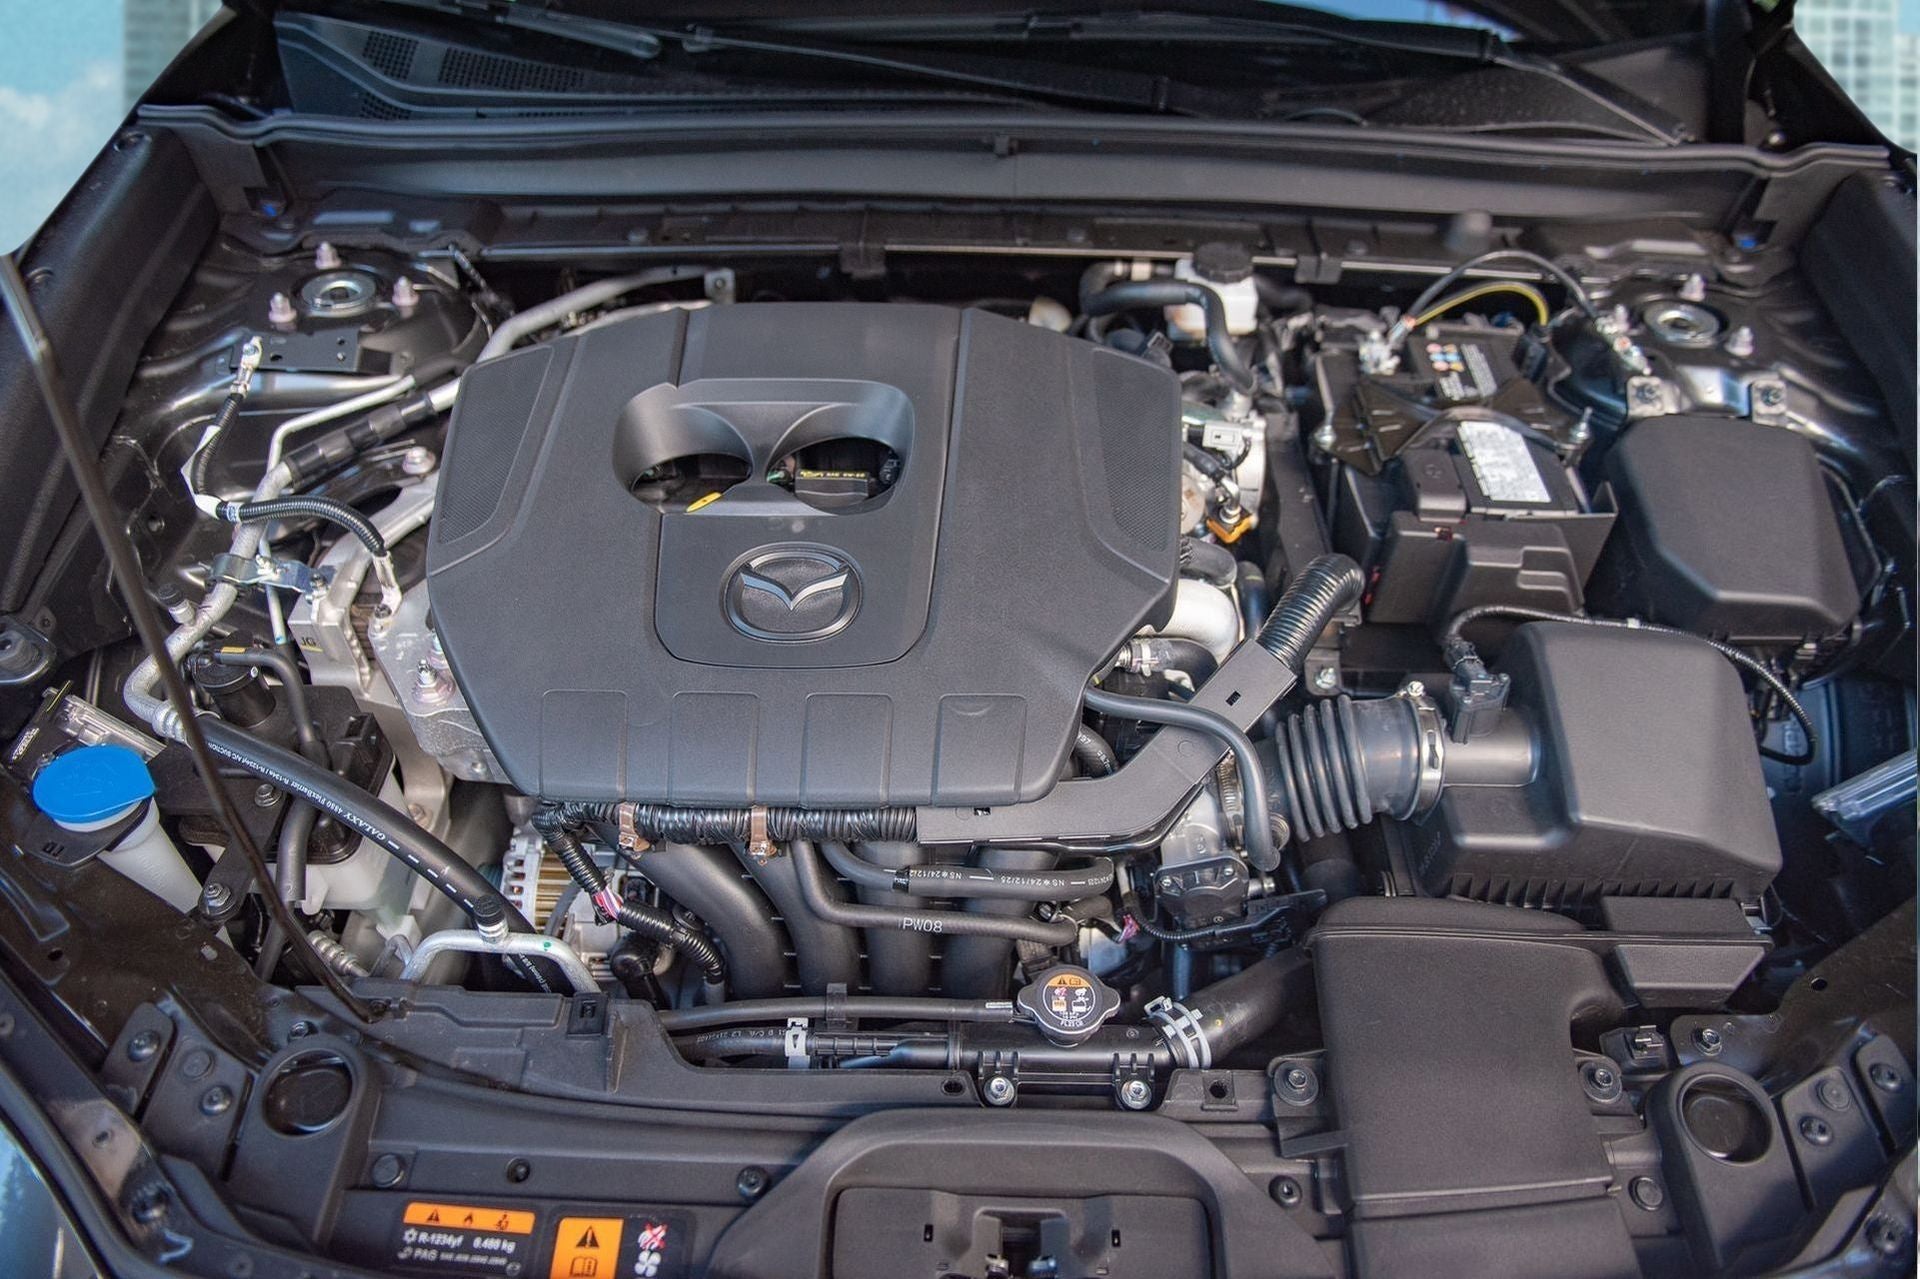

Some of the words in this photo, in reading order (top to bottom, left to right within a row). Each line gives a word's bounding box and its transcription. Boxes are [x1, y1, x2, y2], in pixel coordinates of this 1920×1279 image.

[343, 812, 386, 840] GALAXY
[902, 917, 943, 933] PW08
[414, 1247, 438, 1262] PAG
